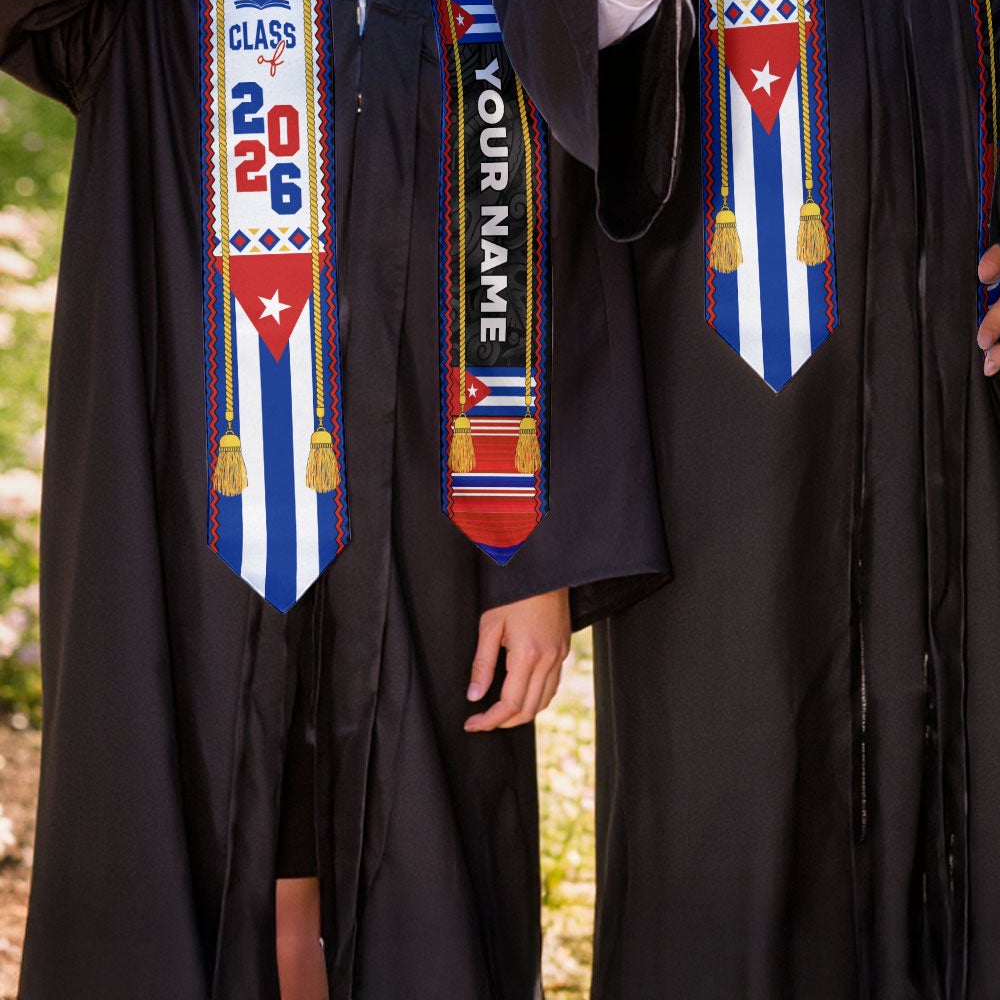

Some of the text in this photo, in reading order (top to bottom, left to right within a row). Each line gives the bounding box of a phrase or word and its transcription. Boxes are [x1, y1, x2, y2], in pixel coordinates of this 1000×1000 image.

[229, 19, 297, 51] CLASS
[257, 40, 286, 77] of
[474, 57, 510, 343] YOUR NAME
